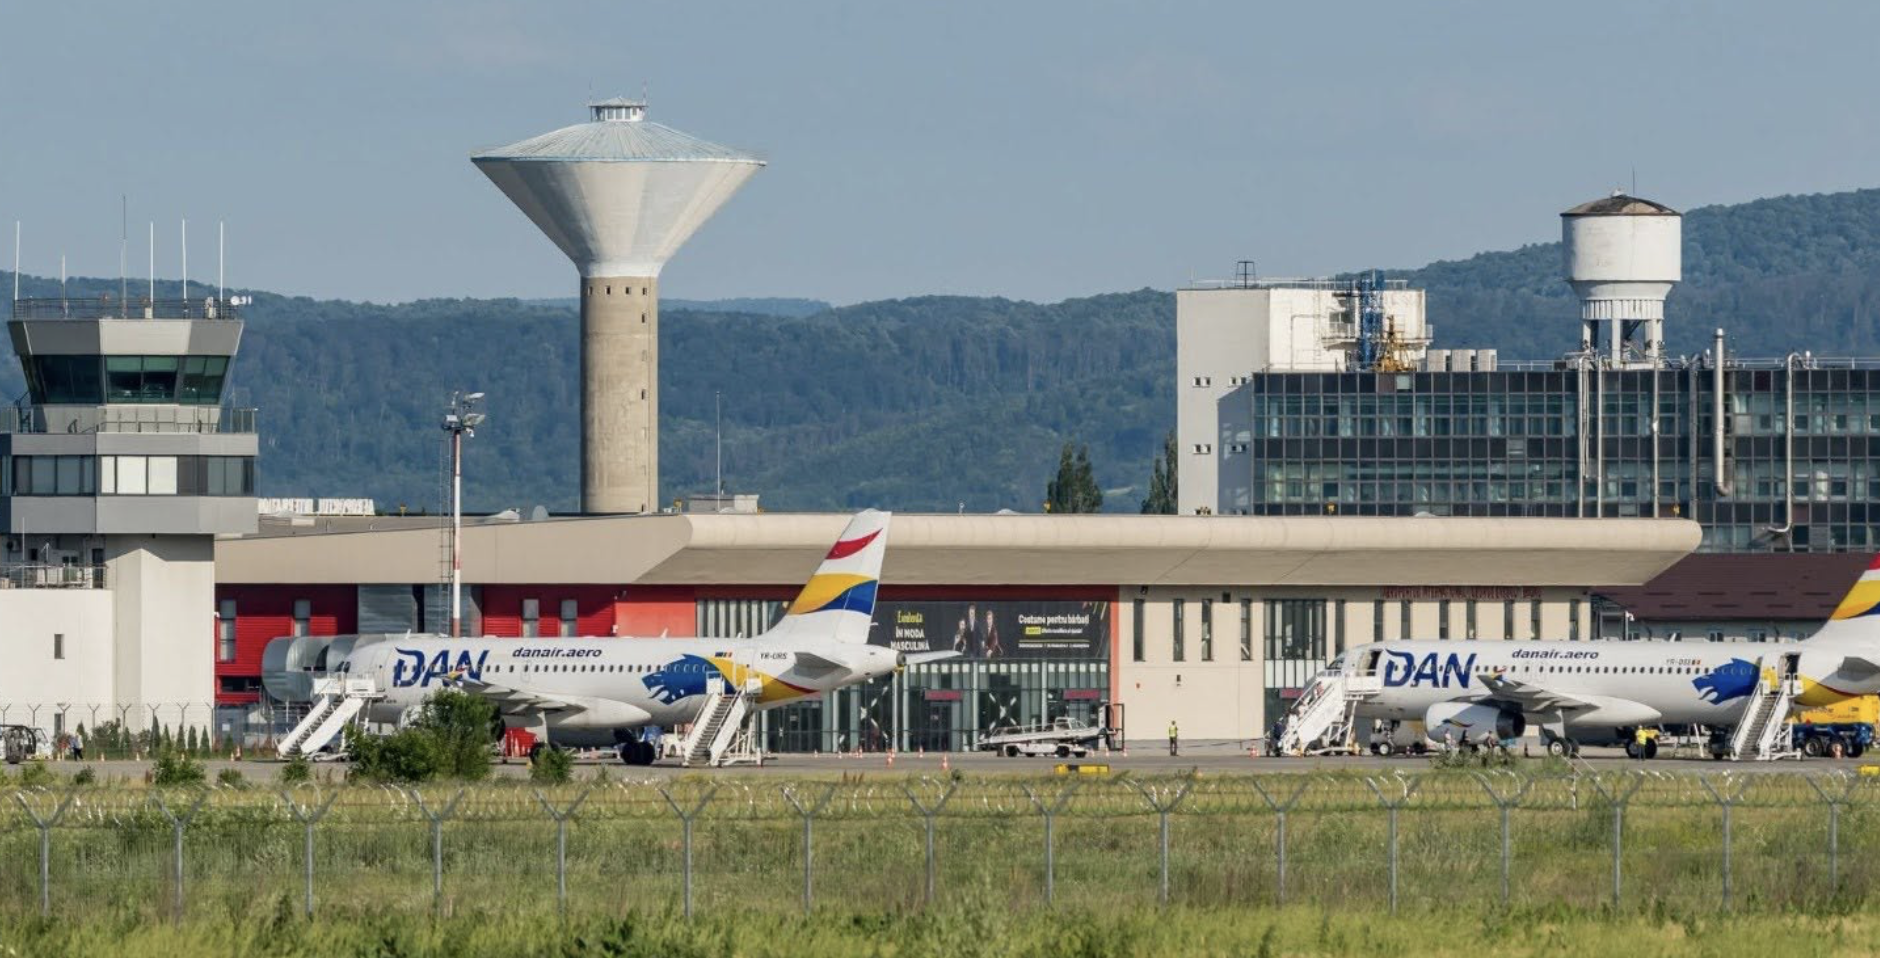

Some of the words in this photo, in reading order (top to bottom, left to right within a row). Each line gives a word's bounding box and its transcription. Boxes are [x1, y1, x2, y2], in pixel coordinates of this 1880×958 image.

[904, 628, 925, 638] MODA
[512, 647, 602, 658] danair.aero
[1512, 649, 1599, 660] danair.aero
[393, 647, 490, 687] DAN
[1384, 648, 1477, 689] DAN
